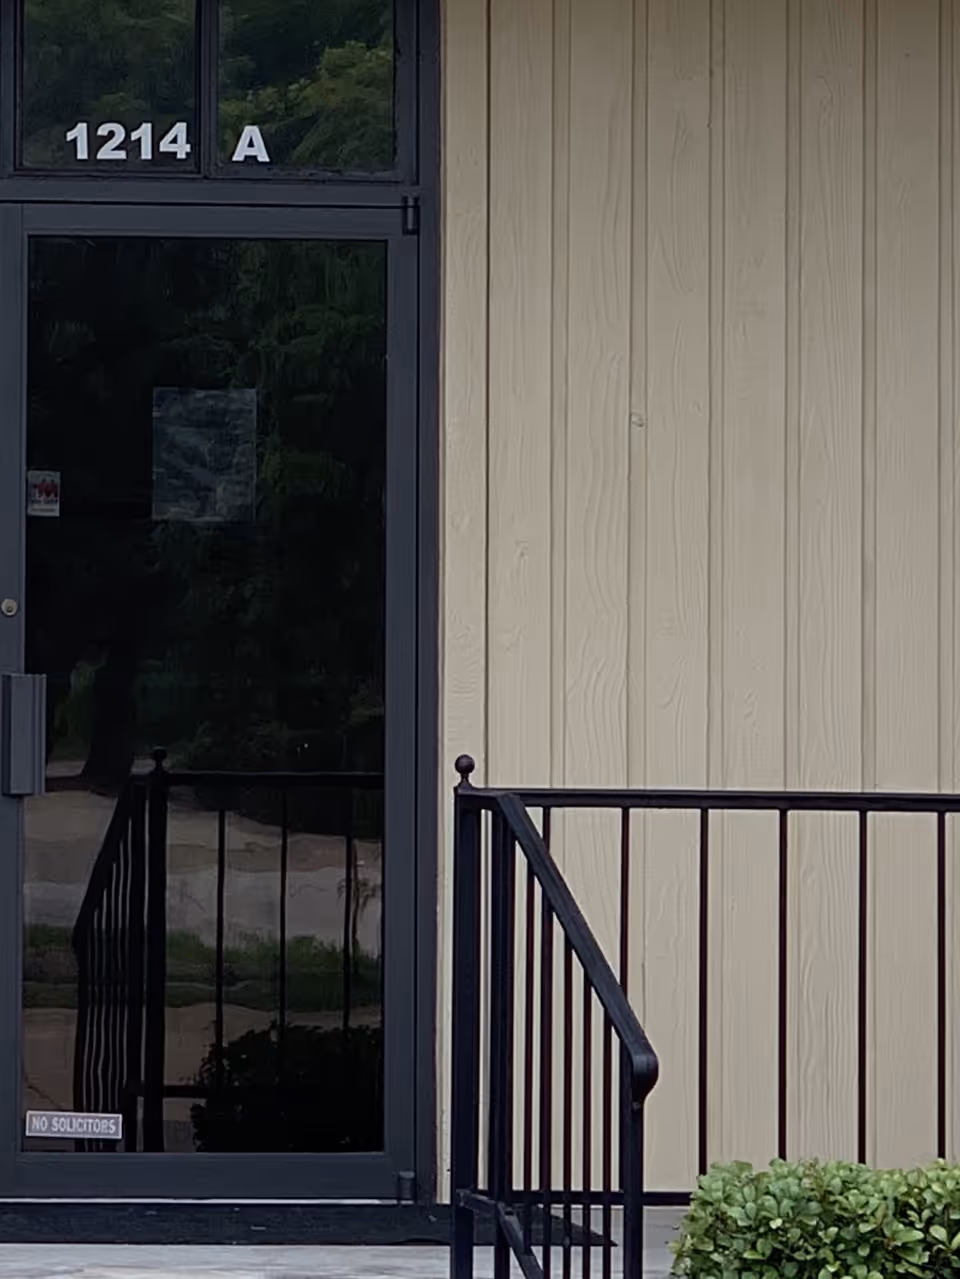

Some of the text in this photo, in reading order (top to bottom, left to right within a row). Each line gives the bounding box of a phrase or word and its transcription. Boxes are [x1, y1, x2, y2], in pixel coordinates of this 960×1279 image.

[66, 122, 270, 162] 1214 A
[32, 1116, 116, 1134] NO SOLICITORS
